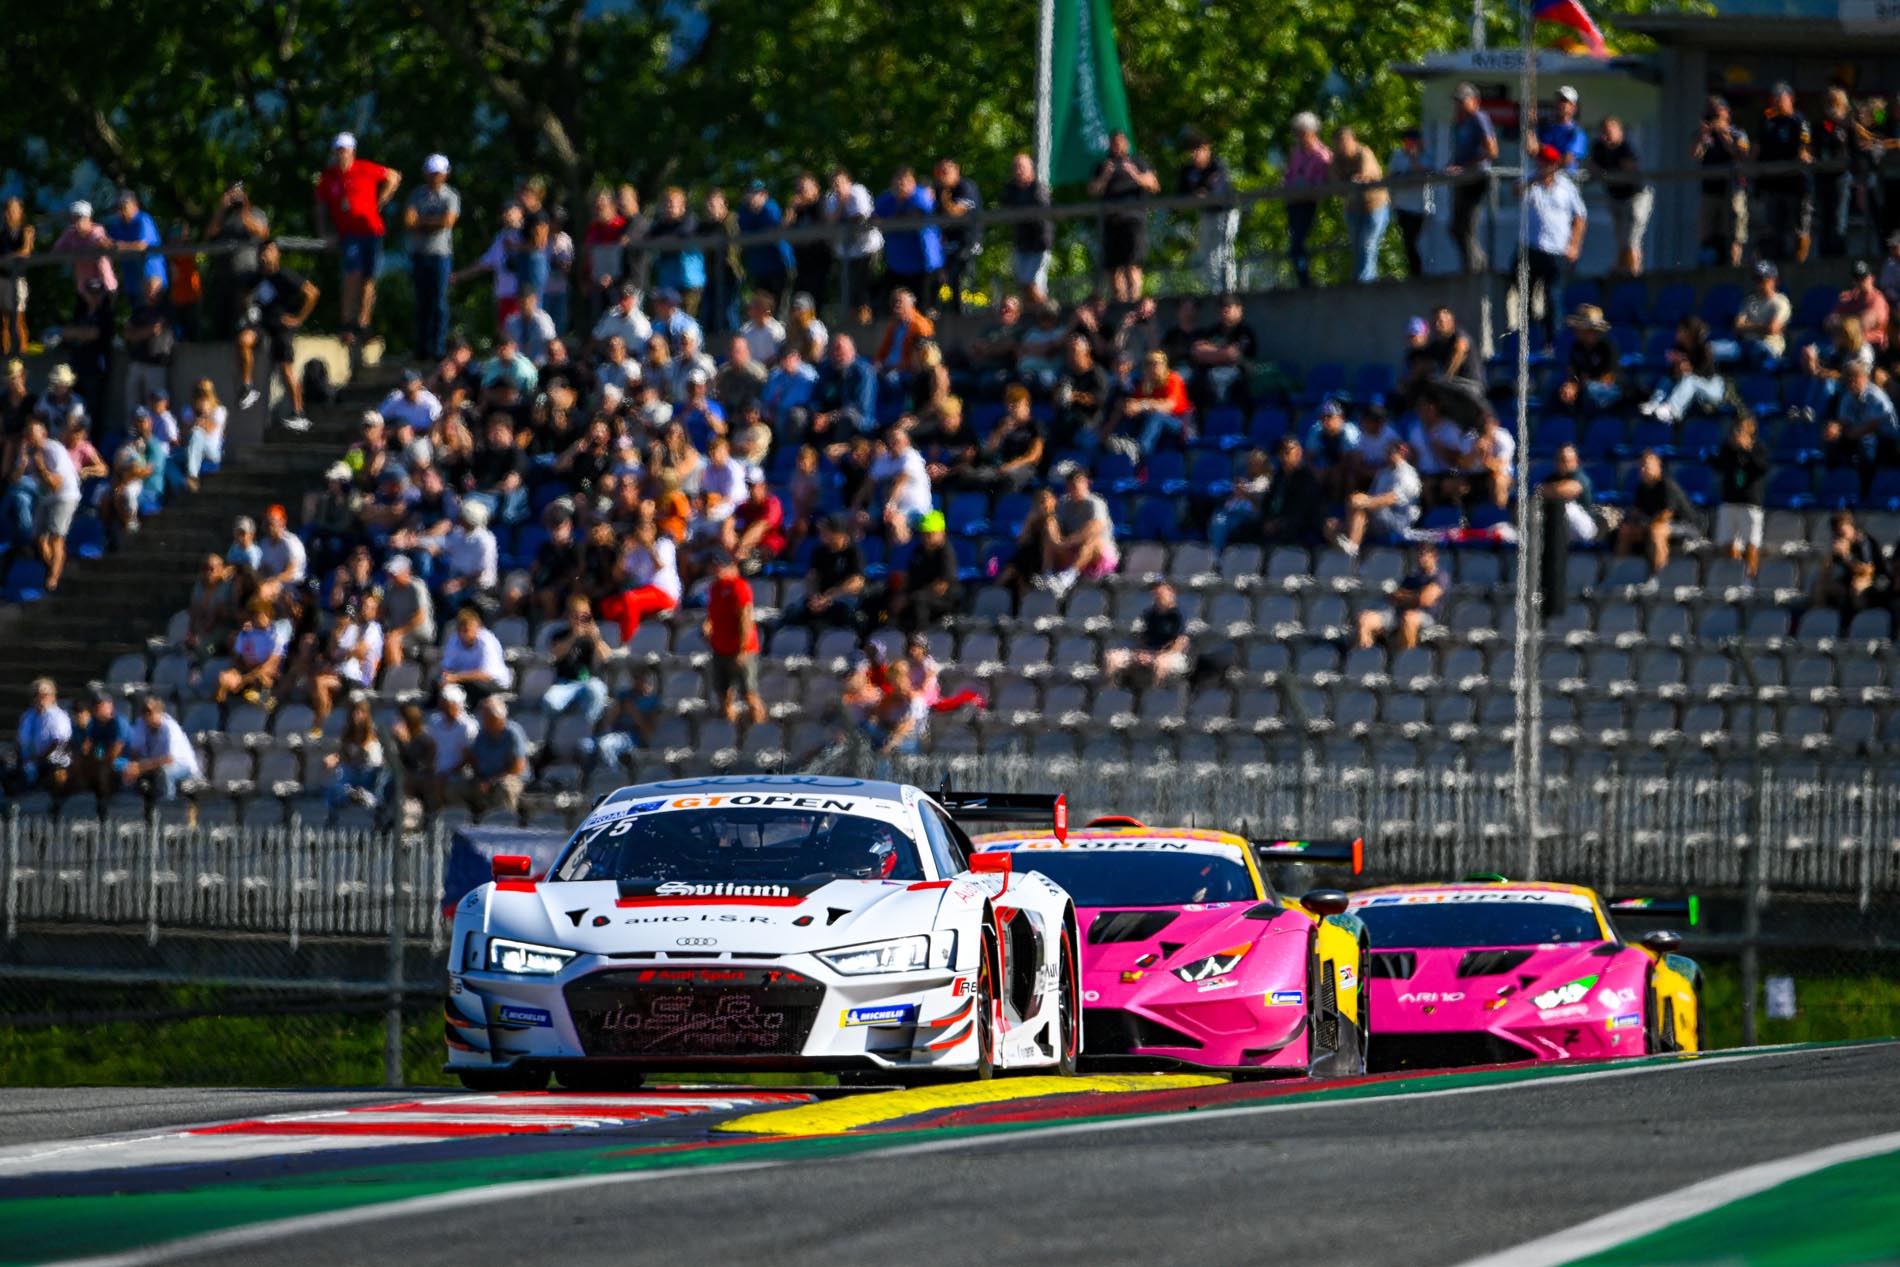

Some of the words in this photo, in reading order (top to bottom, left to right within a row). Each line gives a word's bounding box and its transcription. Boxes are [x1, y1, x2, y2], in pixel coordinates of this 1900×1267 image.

[586, 817, 638, 843] 75
[625, 915, 689, 925] auto
[658, 970, 695, 980] Audi
[701, 970, 745, 981] Sport
[508, 1011, 547, 1022] MICHELIN
[860, 1009, 905, 1020] MICHELIN
